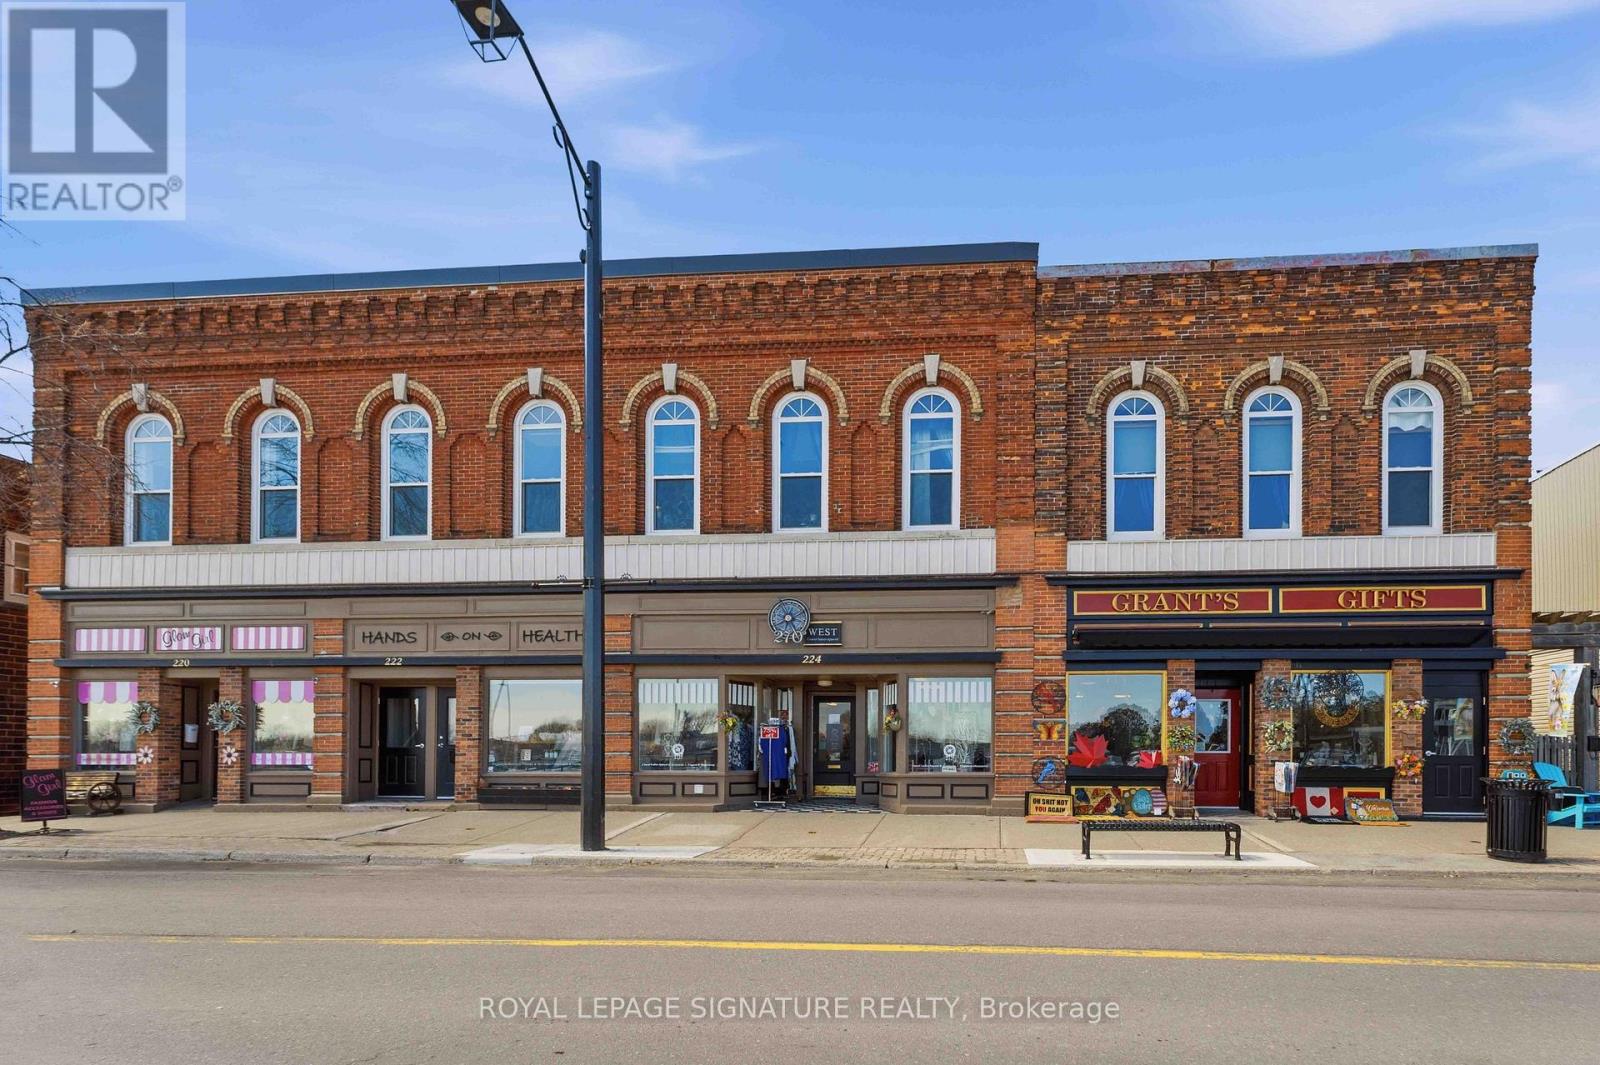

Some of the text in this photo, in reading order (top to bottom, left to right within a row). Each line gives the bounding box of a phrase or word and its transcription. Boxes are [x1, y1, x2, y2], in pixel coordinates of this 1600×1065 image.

[1112, 589, 1427, 611] GRANT'S GIFTS
[808, 628, 838, 636] WEST
[191, 629, 215, 650] Girl
[361, 631, 418, 644] HANDS
[462, 631, 481, 641] ON
[172, 659, 190, 667] 220
[384, 657, 403, 666] 222
[802, 655, 821, 664] 224
